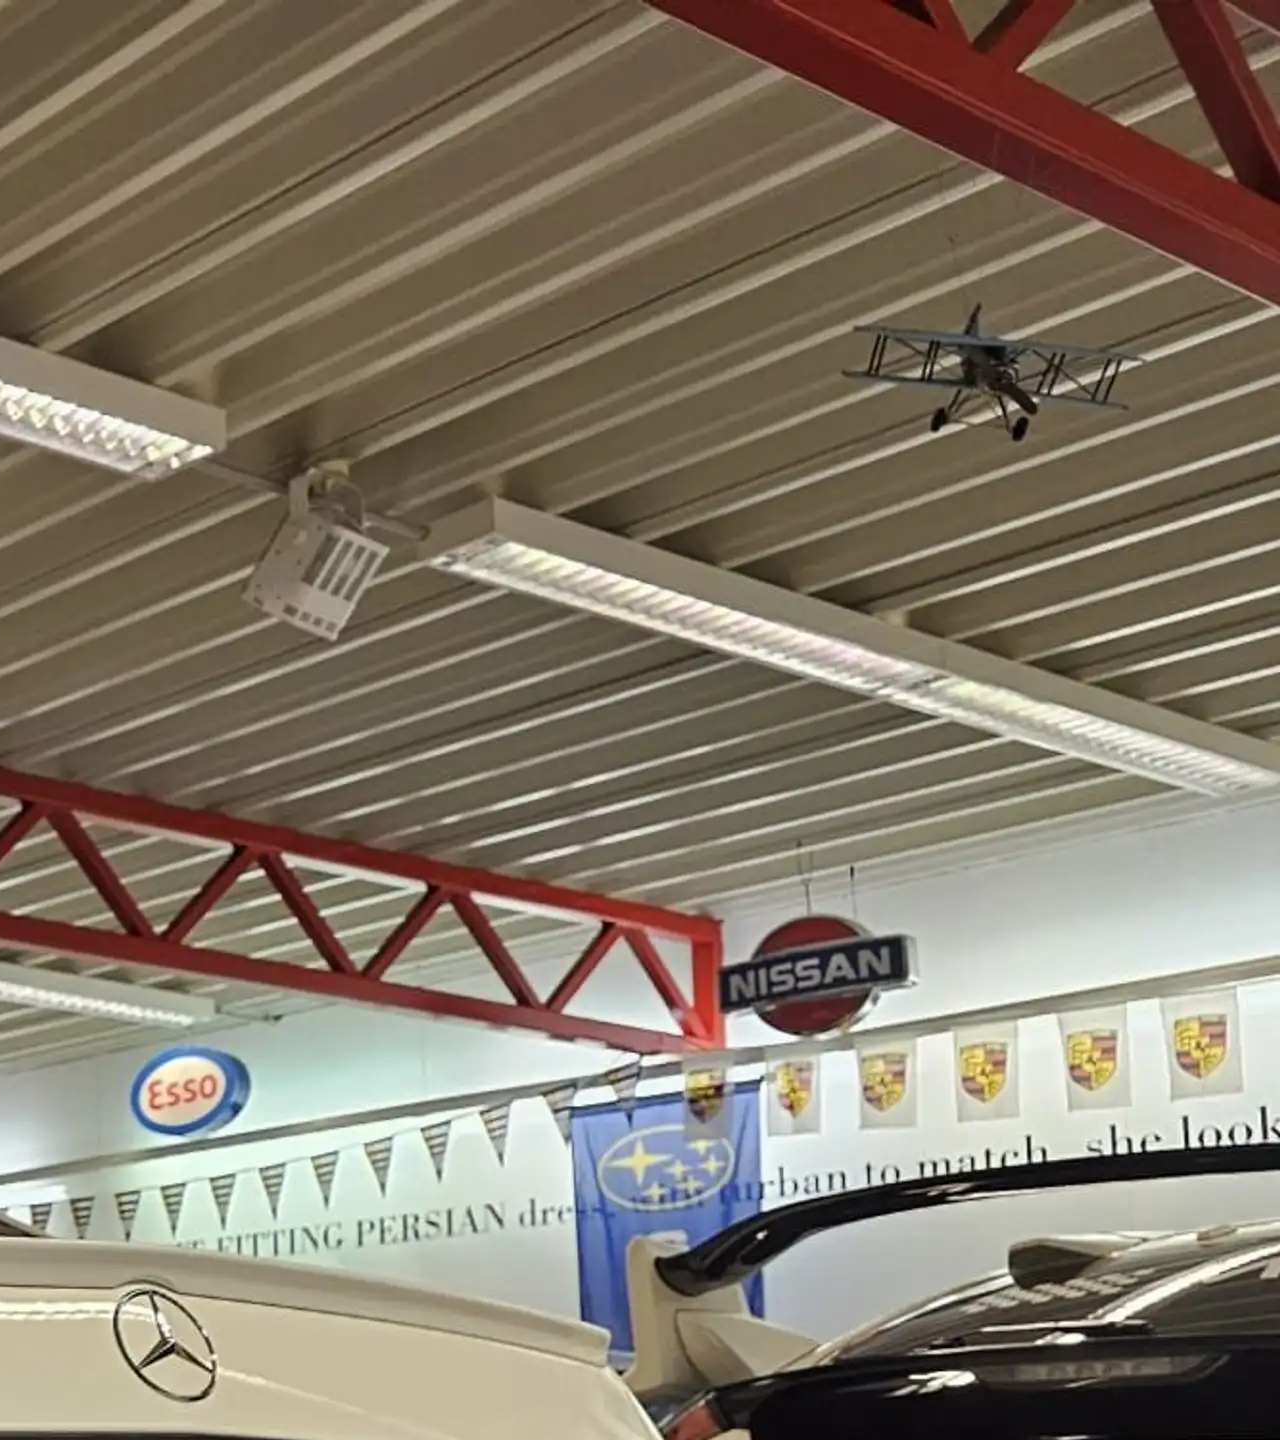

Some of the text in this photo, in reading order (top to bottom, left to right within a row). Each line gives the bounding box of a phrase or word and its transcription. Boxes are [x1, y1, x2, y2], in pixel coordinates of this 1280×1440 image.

[728, 947, 891, 1001] NISSAN
[217, 1221, 343, 1258] FITTING
[356, 1201, 507, 1247] PERSIAN
[865, 1161, 901, 1186] to
[1086, 1123, 1162, 1157] she
